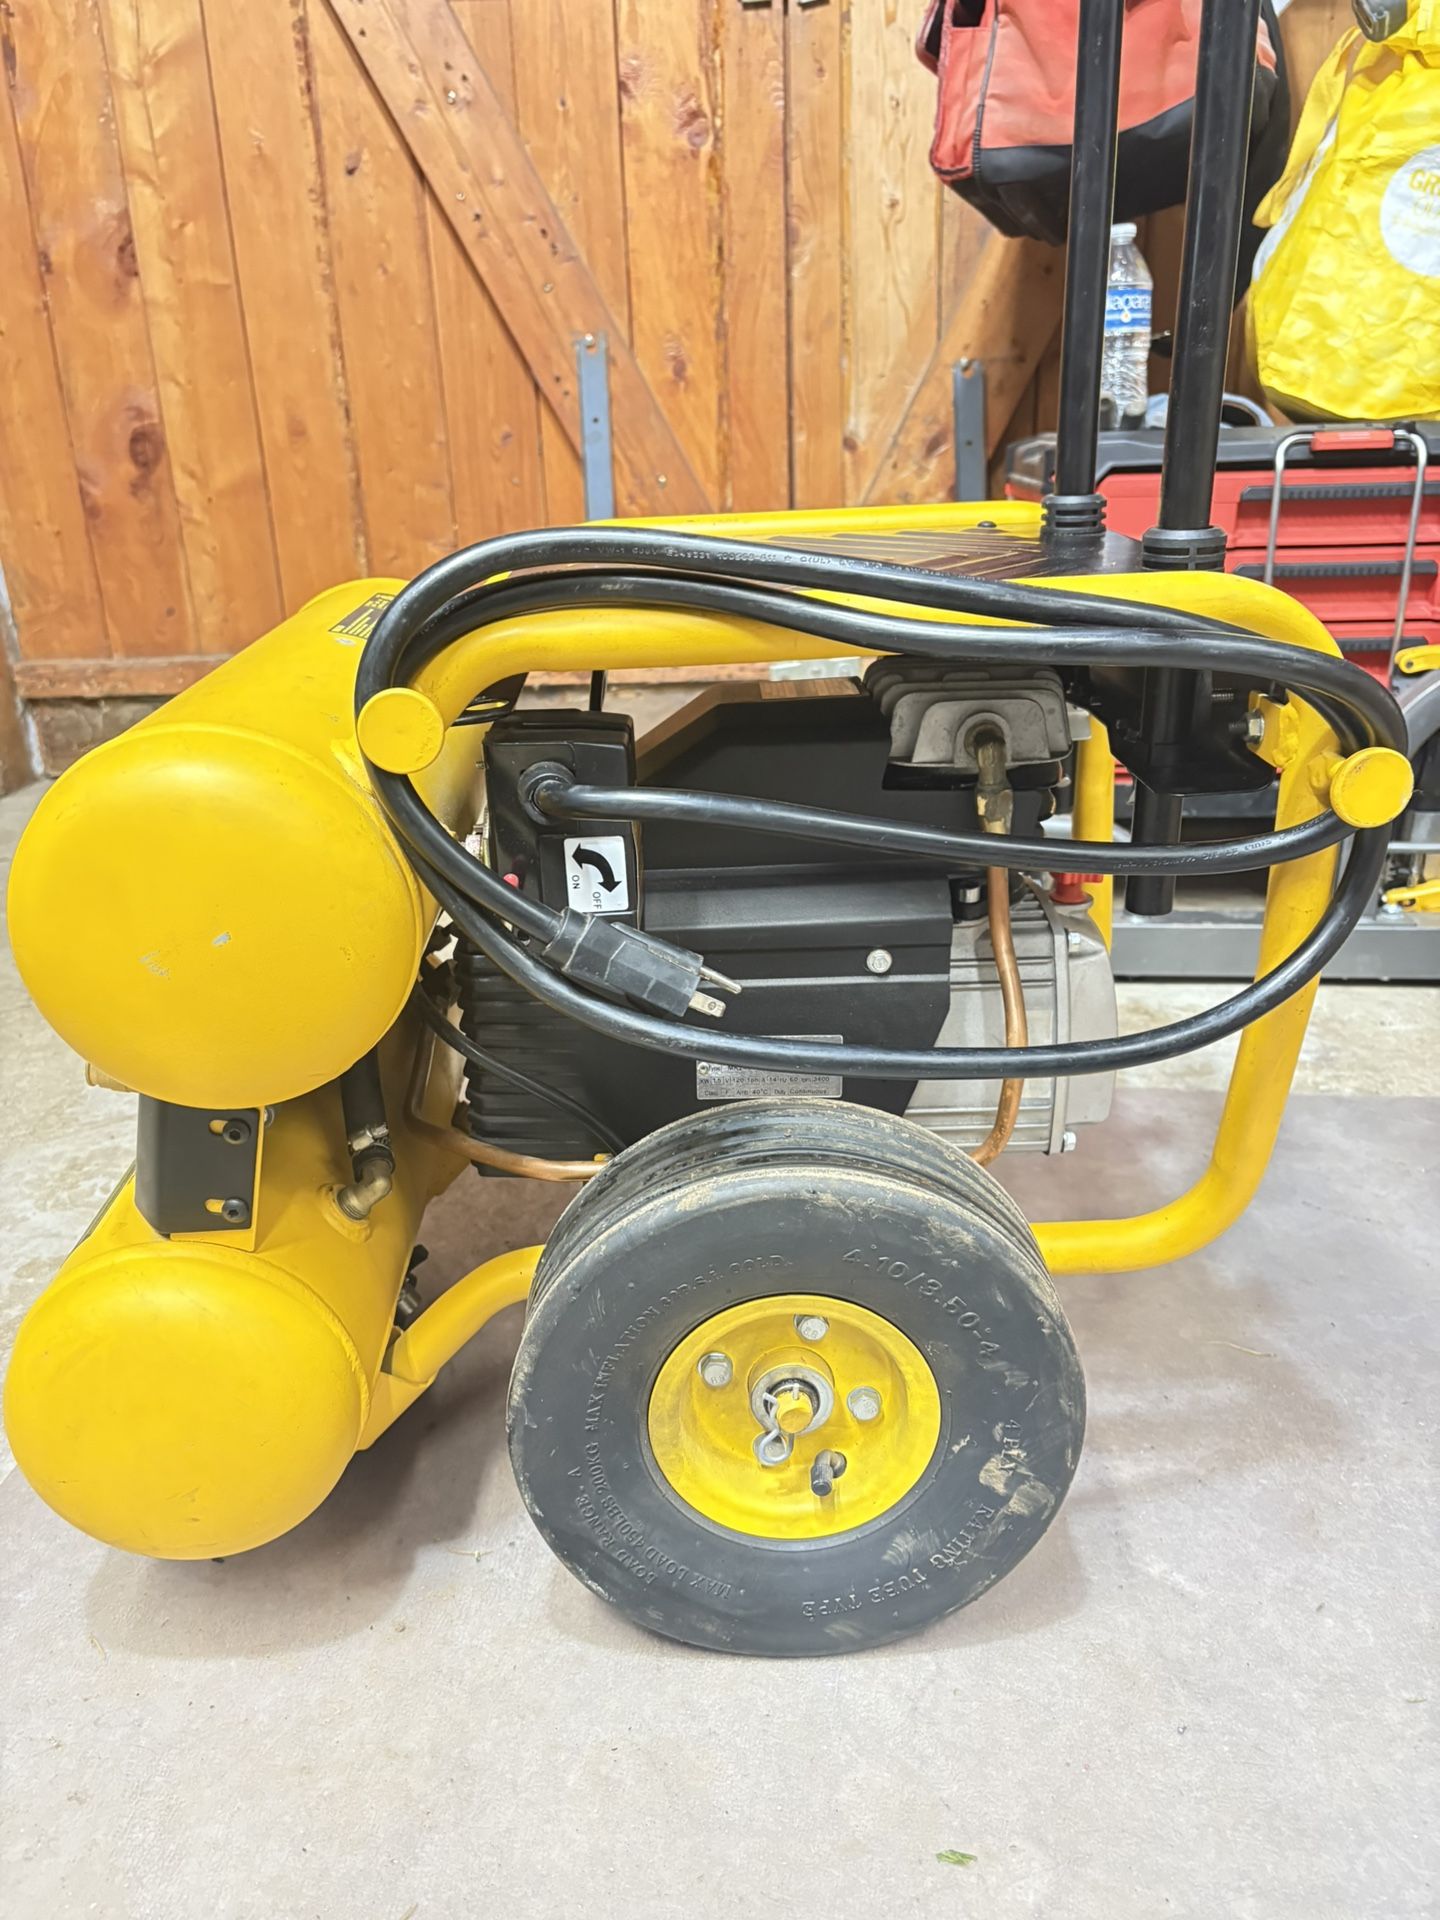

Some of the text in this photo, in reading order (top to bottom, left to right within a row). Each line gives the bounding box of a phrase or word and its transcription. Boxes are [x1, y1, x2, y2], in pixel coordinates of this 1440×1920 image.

[571, 874, 581, 890] ON
[592, 891, 603, 910] OFF
[929, 1502, 996, 1570] RATING
[645, 1545, 690, 1581] LOAD
[867, 1567, 928, 1604] TUBE
[801, 1593, 863, 1618] TYPE
